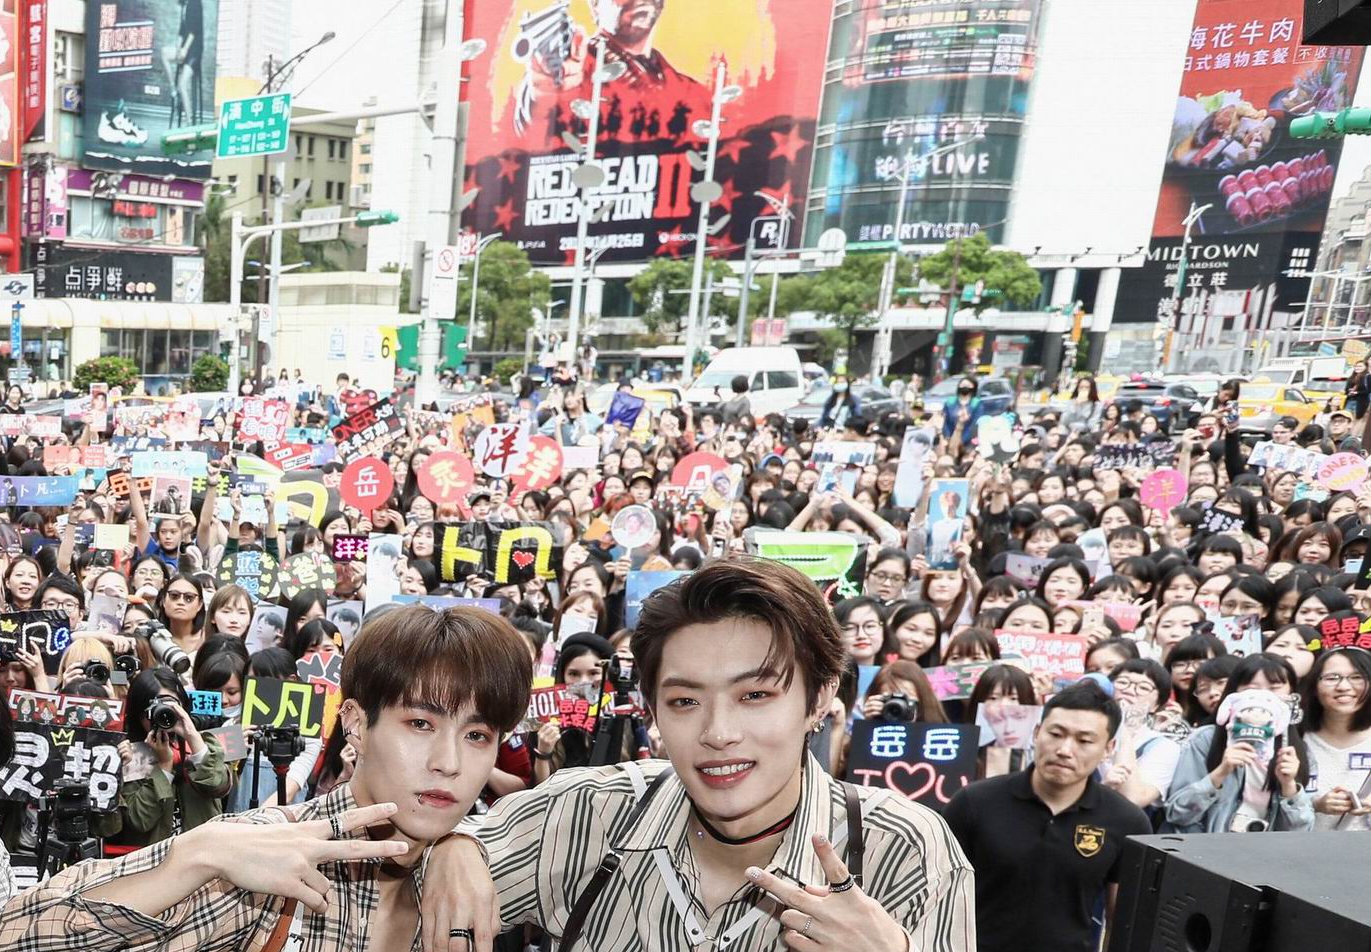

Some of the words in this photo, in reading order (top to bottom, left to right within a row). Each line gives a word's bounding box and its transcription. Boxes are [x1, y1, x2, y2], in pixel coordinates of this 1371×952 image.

[882, 222, 980, 240] PRTYWORLD
[1146, 243, 1260, 262] MIDTOWN
[381, 336, 390, 359] 6
[334, 410, 375, 442] ONER
[482, 428, 519, 467] 洋
[1321, 456, 1360, 480] ONER
[1148, 478, 1176, 505] 洋
[242, 678, 321, 737] 卜凡
[870, 725, 961, 761] 岳岳
